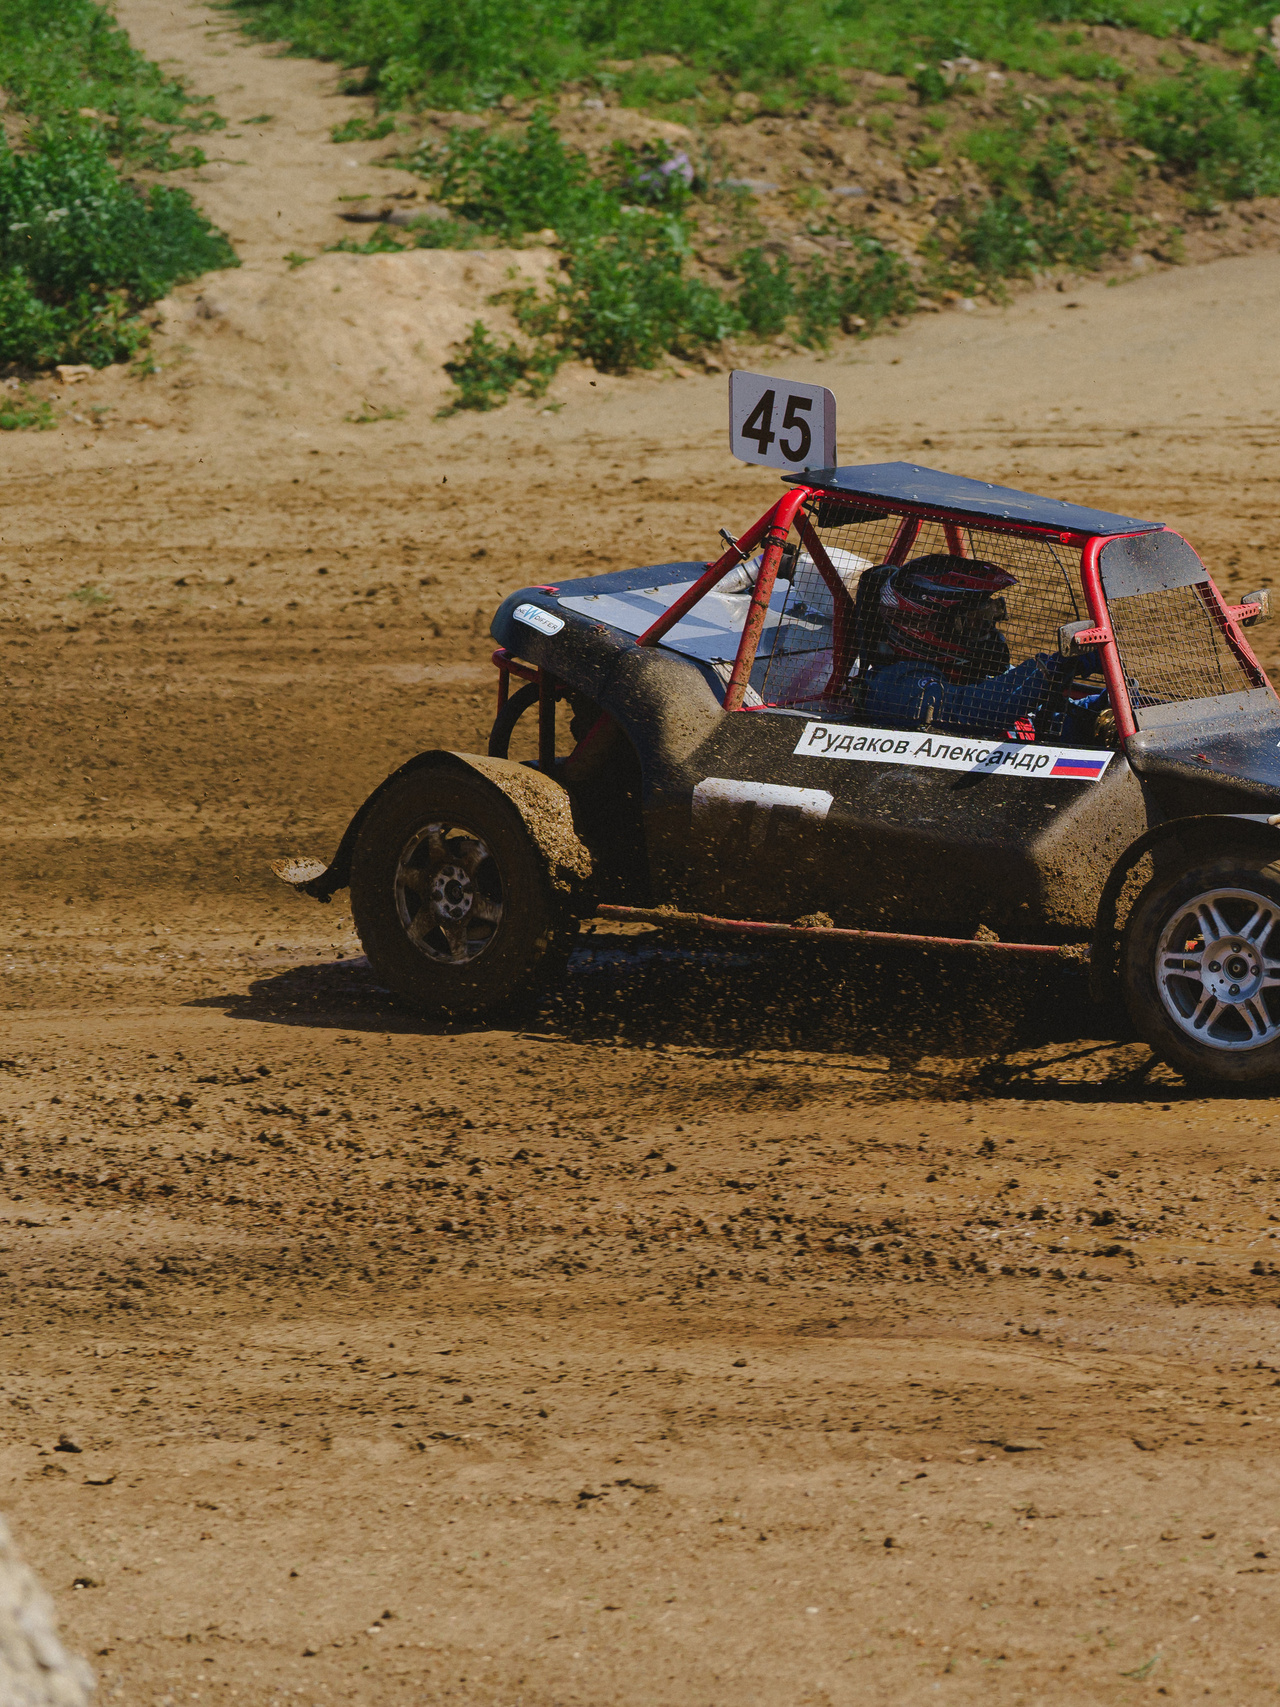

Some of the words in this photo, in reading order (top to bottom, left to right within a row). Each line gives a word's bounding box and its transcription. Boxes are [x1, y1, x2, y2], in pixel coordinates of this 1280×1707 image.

[741, 389, 813, 462] 45
[807, 726, 910, 754] Рудаков
[914, 737, 1050, 772] Александр
